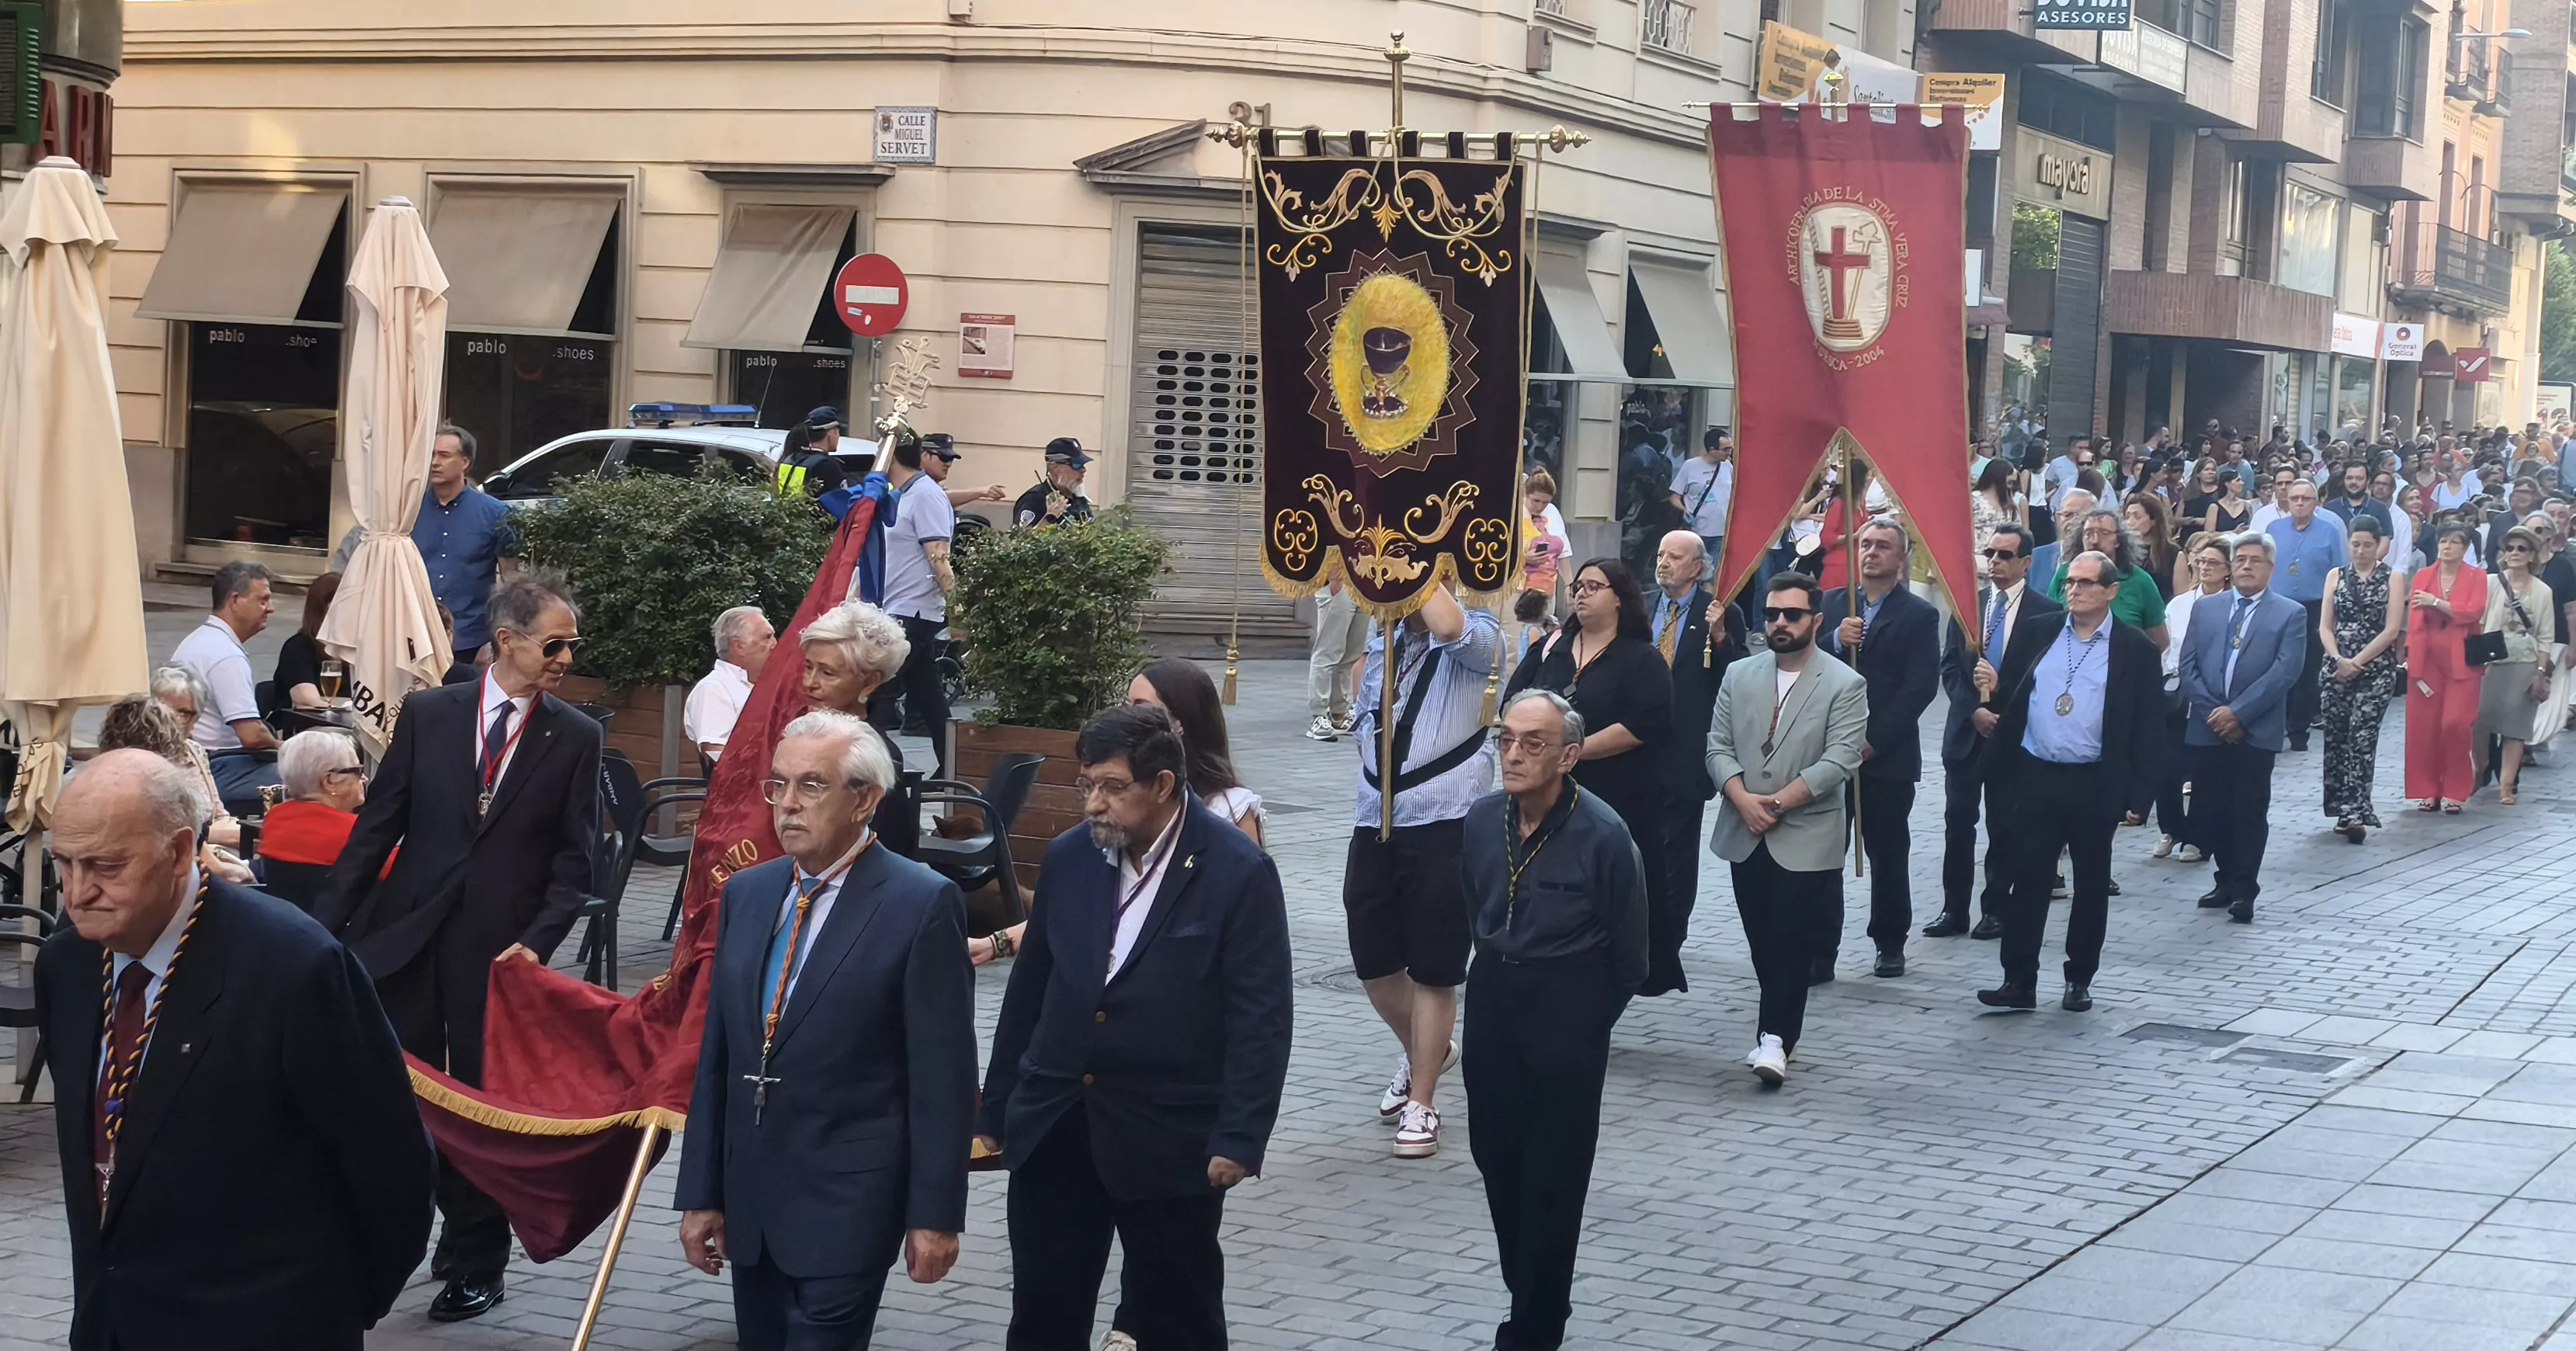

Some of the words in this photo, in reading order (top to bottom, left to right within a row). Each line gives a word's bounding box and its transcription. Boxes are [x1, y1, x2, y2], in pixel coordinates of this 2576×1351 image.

[2037, 11, 2126, 24] ASESORES
[898, 115, 926, 126] CALLE
[894, 128, 925, 140] MIGUEL
[880, 141, 928, 155] SERVET
[1823, 187, 1843, 200] DE
[1845, 186, 1864, 203] LA
[1894, 233, 1908, 271] VERA
[1895, 275, 1909, 307] CRUZ
[210, 329, 245, 343] pablo
[467, 339, 506, 356] pablo
[553, 345, 594, 360] .shoes
[746, 355, 777, 368] pablo
[814, 357, 845, 368] .shoes
[353, 681, 386, 733] BA
